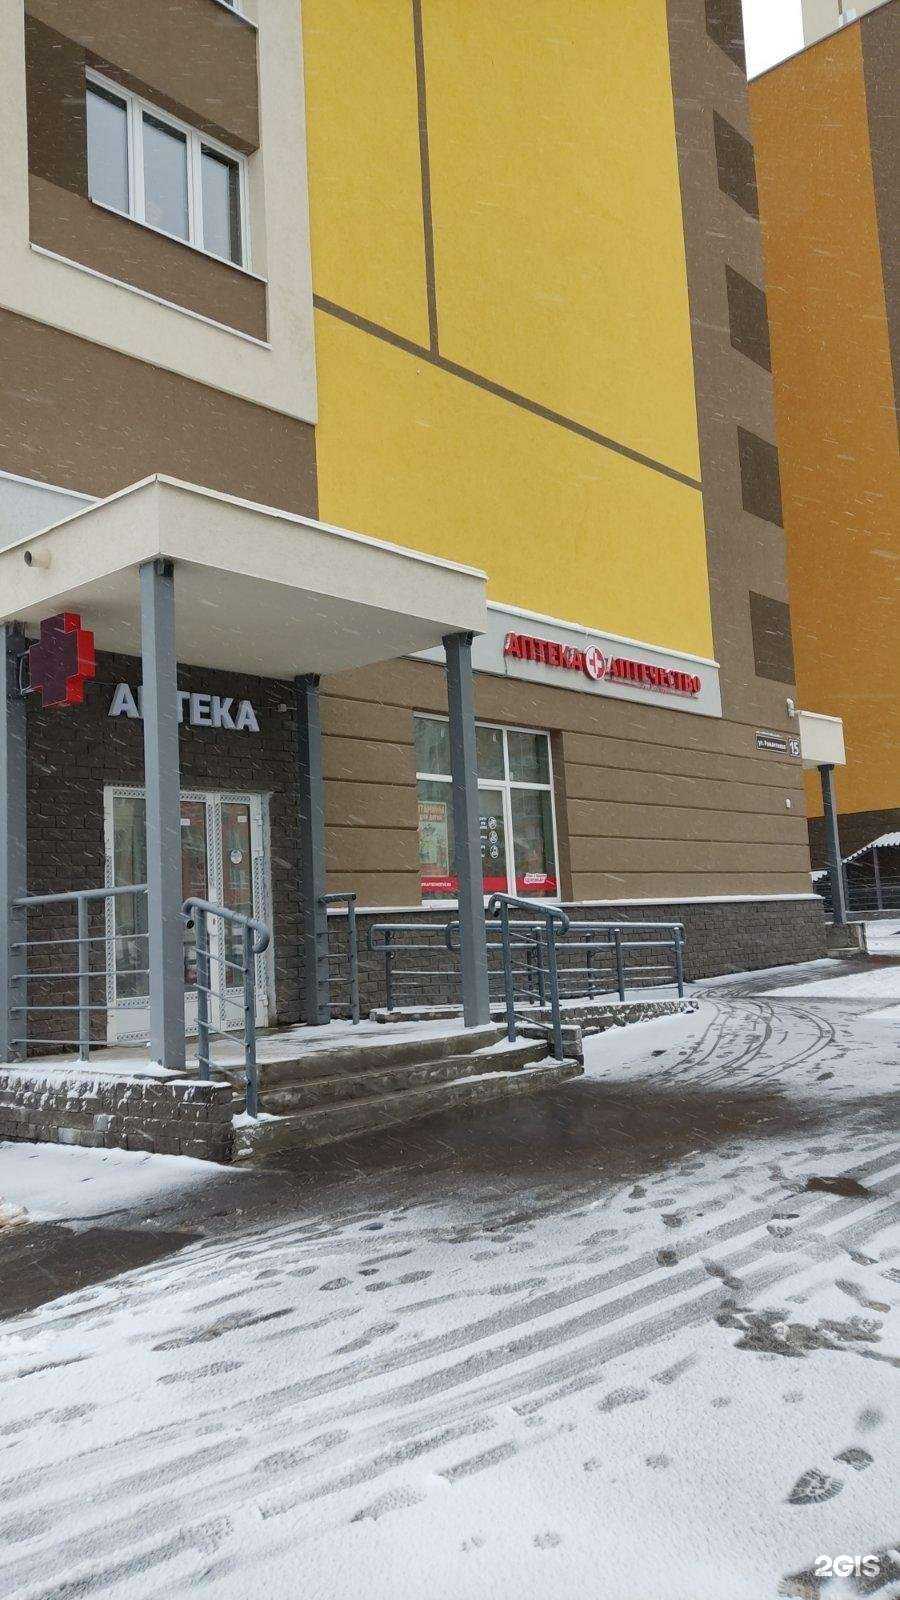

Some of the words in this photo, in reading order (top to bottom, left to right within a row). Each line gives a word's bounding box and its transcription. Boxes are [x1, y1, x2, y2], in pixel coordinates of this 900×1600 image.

[504, 630, 584, 671] АПТЕКА
[606, 655, 702, 694] АПТЕЧЕСТВО
[108, 683, 260, 732] АТЕКА
[789, 741, 799, 755] 15
